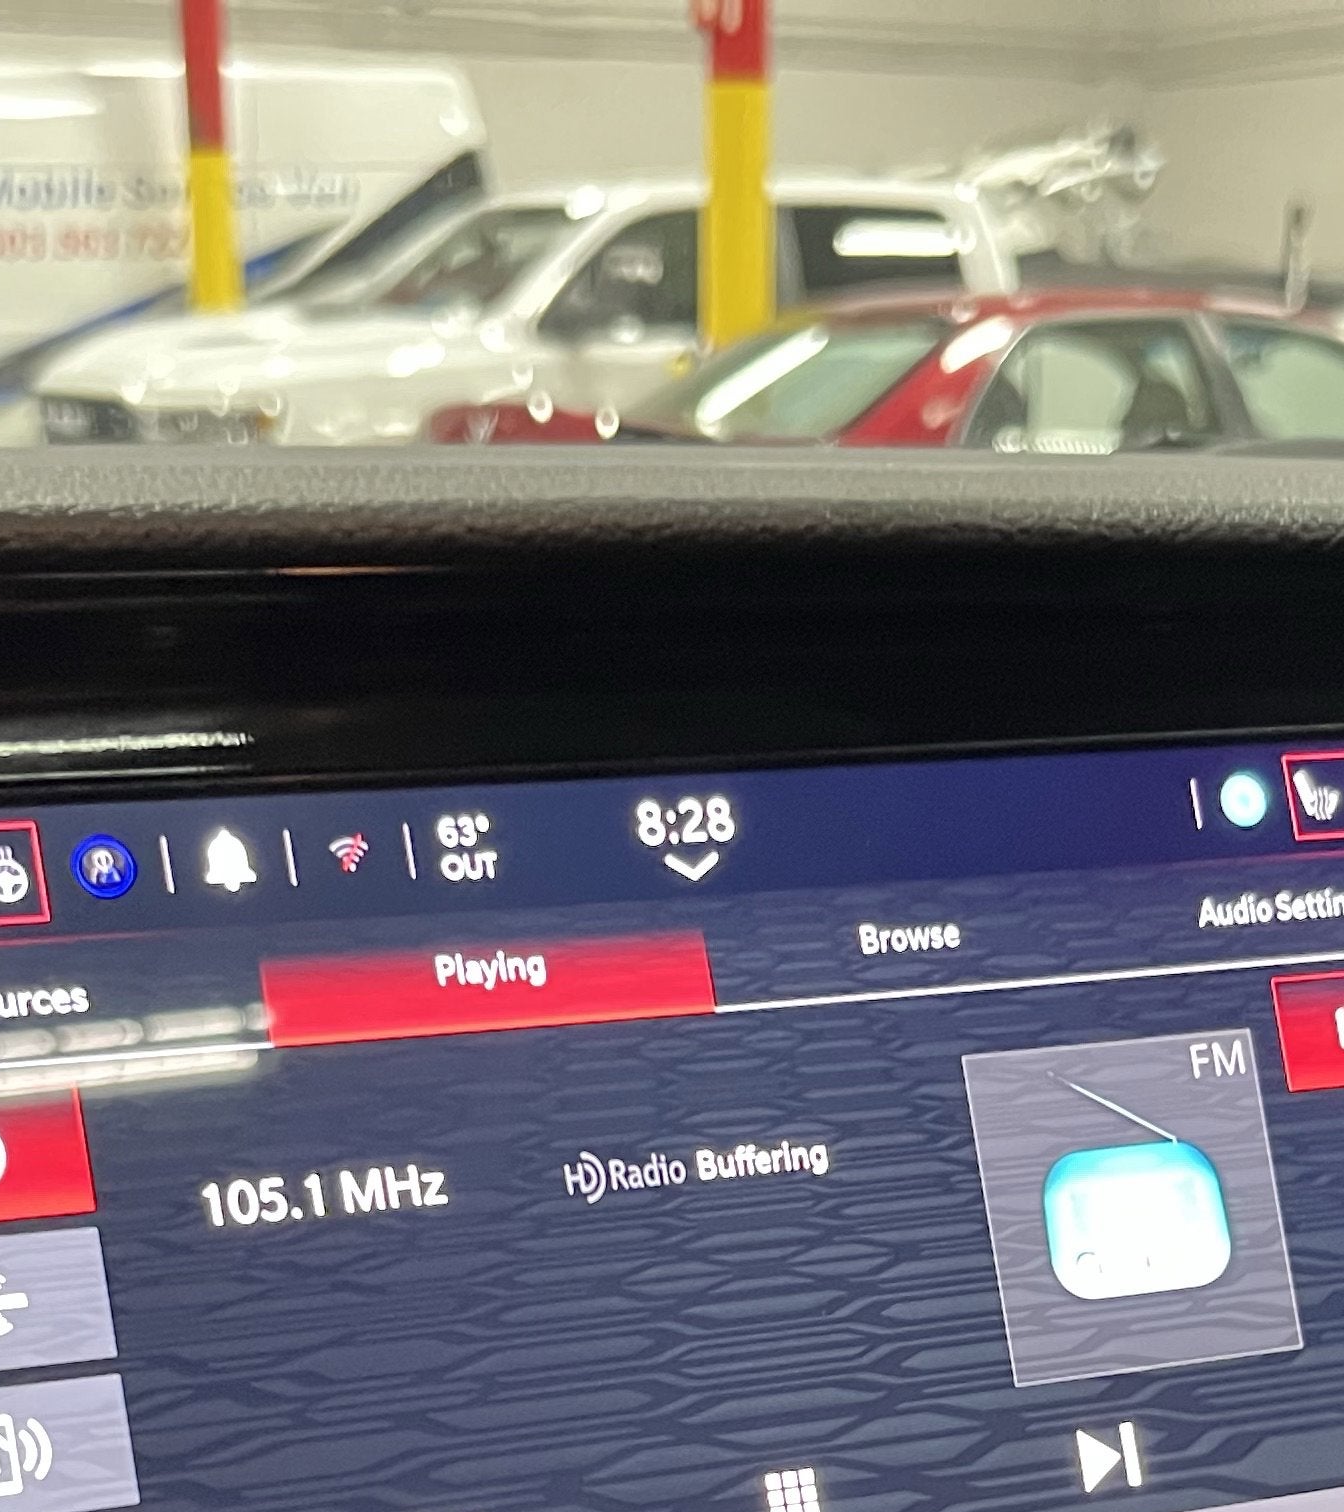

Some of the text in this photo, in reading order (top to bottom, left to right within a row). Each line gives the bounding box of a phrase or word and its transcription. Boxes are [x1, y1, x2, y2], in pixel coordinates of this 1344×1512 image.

[434, 811, 491, 850] 63°
[634, 794, 737, 848] 8:28
[438, 850, 499, 883] OUT
[1197, 891, 1274, 930] Audio
[857, 921, 962, 956] Browse
[433, 948, 548, 992] Playing
[1190, 1040, 1247, 1081] FM
[607, 1151, 688, 1192] Radio
[694, 1139, 831, 1182] Buffering
[200, 1162, 450, 1228] 105.1 MHz
